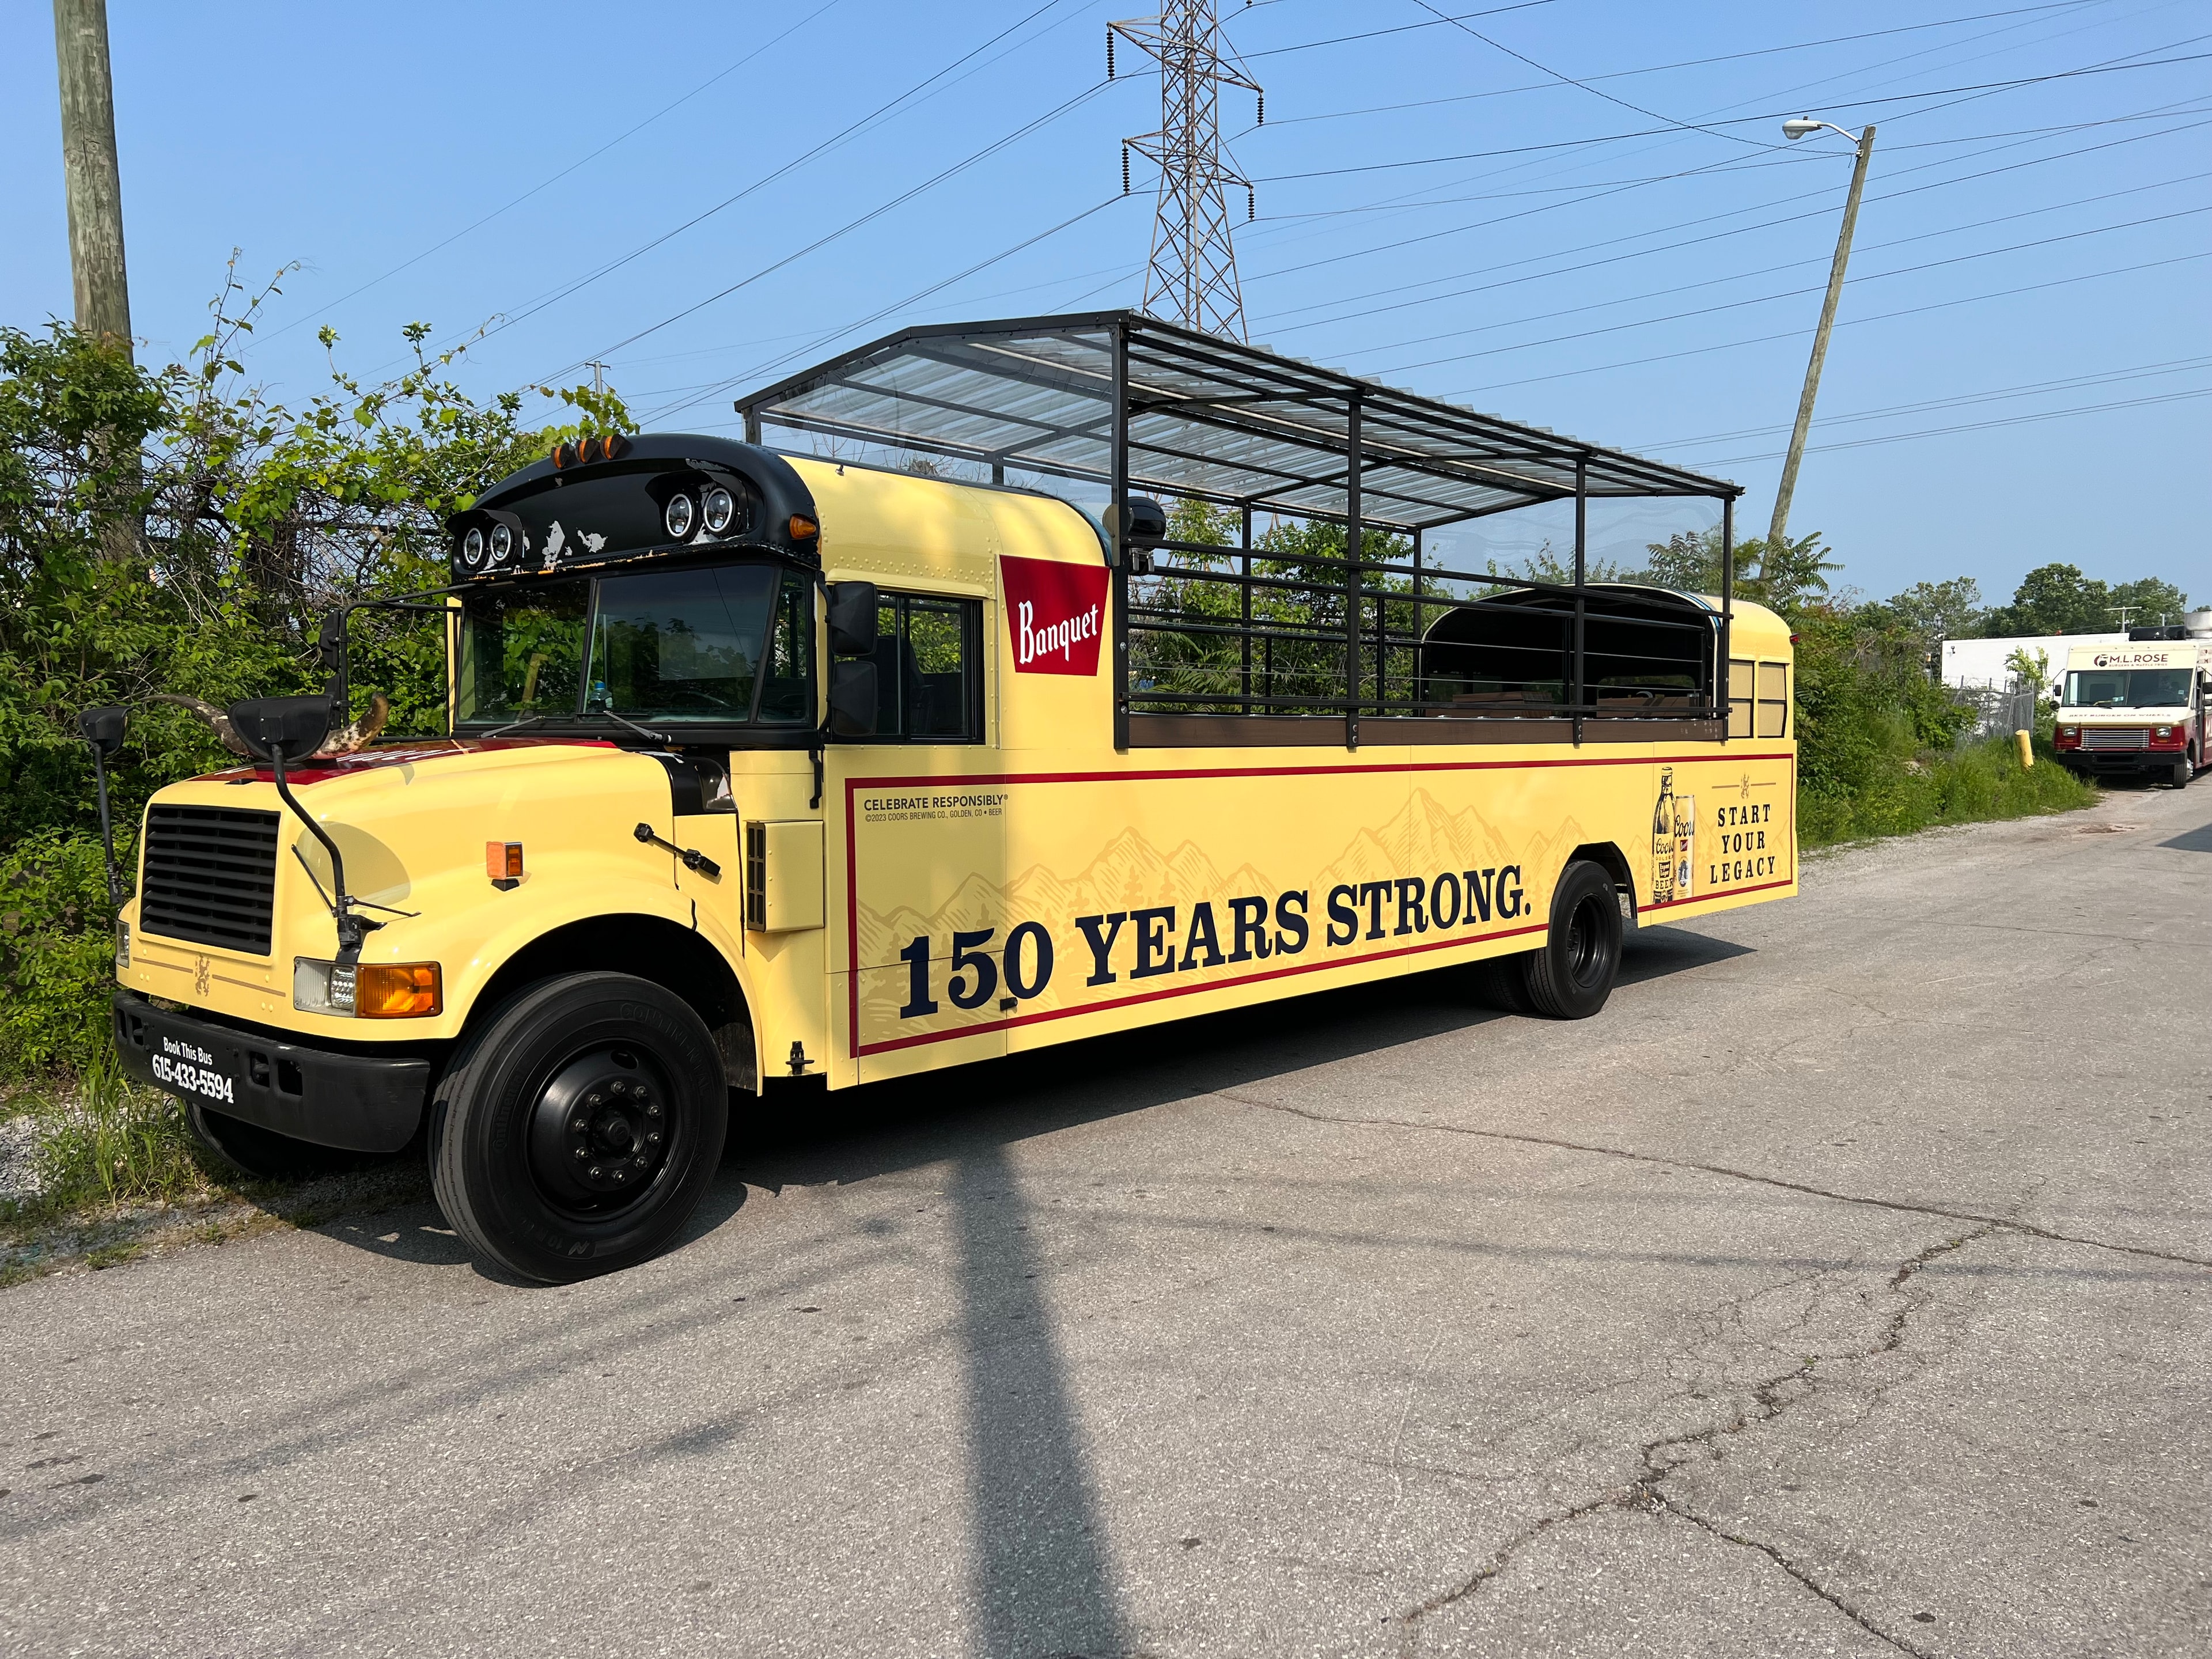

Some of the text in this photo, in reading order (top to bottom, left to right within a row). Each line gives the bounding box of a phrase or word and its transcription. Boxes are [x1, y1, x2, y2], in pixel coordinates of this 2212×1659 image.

[1018, 600, 1099, 665] Banquet
[864, 797, 929, 811] CELEBRATE
[888, 813, 908, 821] COORS
[910, 812, 936, 820] BREWING
[950, 810, 974, 818] GOLDEN,
[989, 808, 1002, 816] BEER
[1718, 804, 1771, 827] START
[1722, 831, 1765, 854] YOUR
[1710, 855, 1775, 884] LEGACY
[1656, 877, 1673, 889] BEER
[900, 865, 1531, 1020] 150 YEARS STRONG.
[163, 1037, 213, 1066] Book This Bus
[152, 1054, 234, 1103] 615-433-5594
